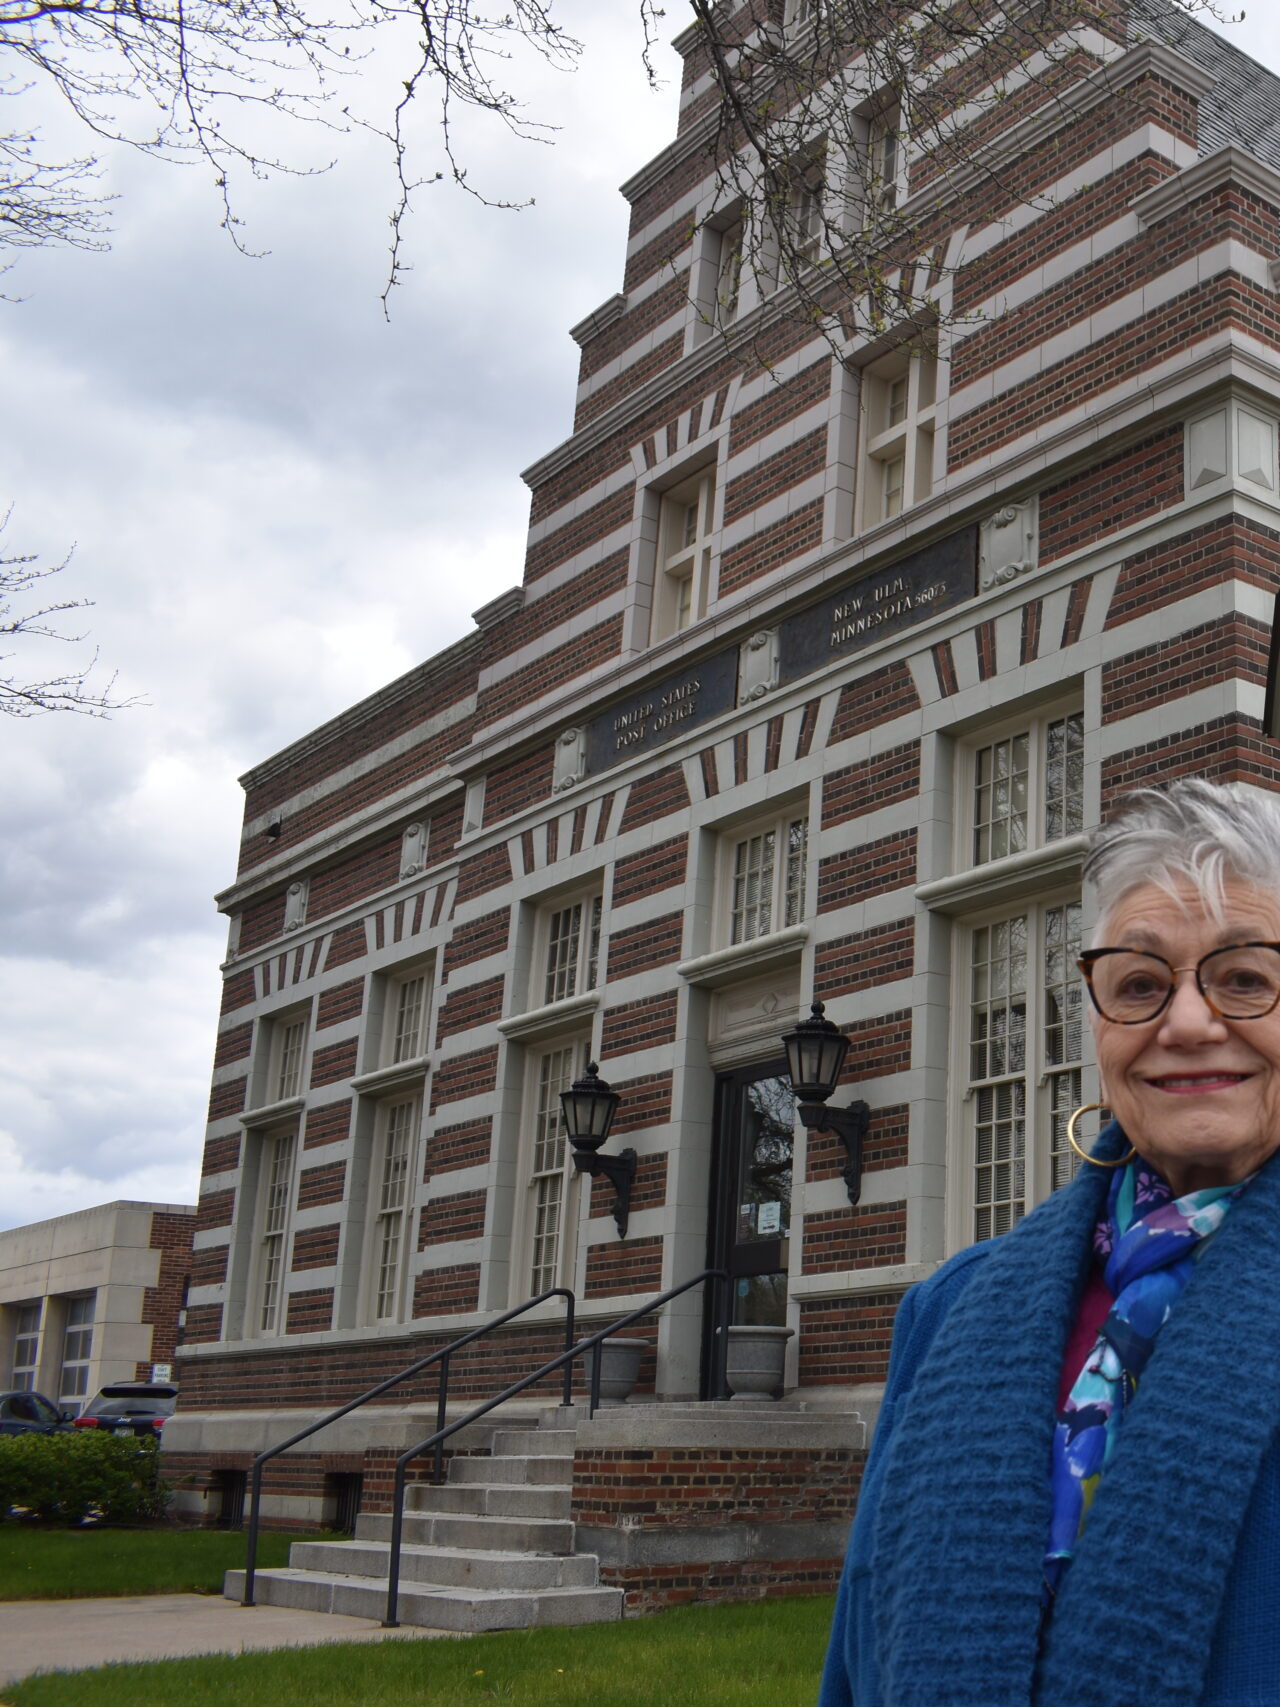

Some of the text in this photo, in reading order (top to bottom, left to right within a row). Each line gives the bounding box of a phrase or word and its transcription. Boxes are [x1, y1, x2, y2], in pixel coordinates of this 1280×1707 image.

[830, 595, 912, 647] MINNESOTA
[834, 596, 865, 622] NEW
[613, 680, 701, 731] UNITED STATES
[616, 701, 696, 750] POST OFFICE
